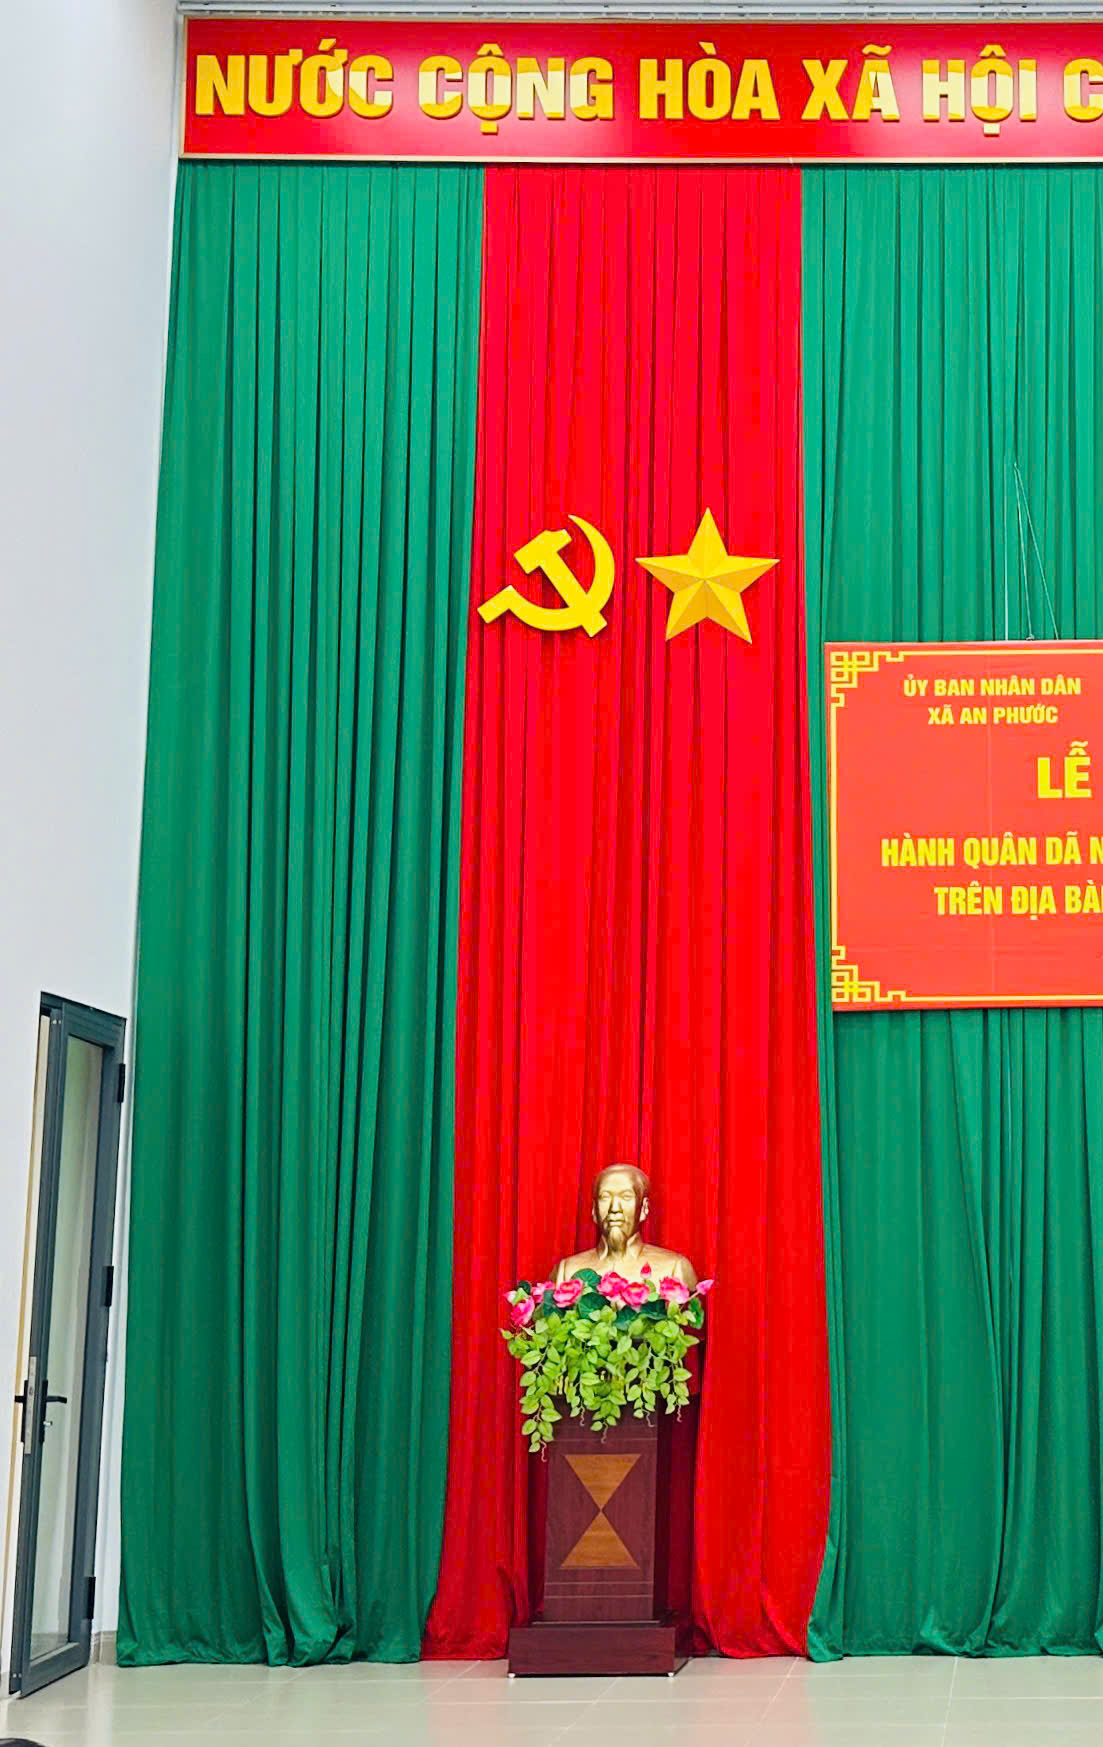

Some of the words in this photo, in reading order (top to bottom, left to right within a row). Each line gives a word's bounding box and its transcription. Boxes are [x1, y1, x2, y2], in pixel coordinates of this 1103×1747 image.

[195, 38, 394, 119] NƯỚC
[418, 43, 615, 134] CỘNG
[638, 41, 781, 121] HÒA
[801, 44, 901, 122] XÃ
[921, 44, 1038, 136] HỘI
[903, 673, 929, 697] ỦY
[933, 678, 975, 697] BAN
[980, 674, 1036, 697] NHÂN
[1040, 673, 1082, 696] DÂN
[927, 703, 955, 725] XÃ
[959, 707, 988, 725] AN
[992, 703, 1059, 725] PHƯỚC
[1037, 740, 1092, 799] LỄ
[881, 832, 955, 867] HÀNH
[963, 831, 1038, 870] QUÂN
[1045, 831, 1083, 865] DÃ
[933, 880, 1003, 916] TRÊN
[1010, 885, 1057, 921] ĐỊA
